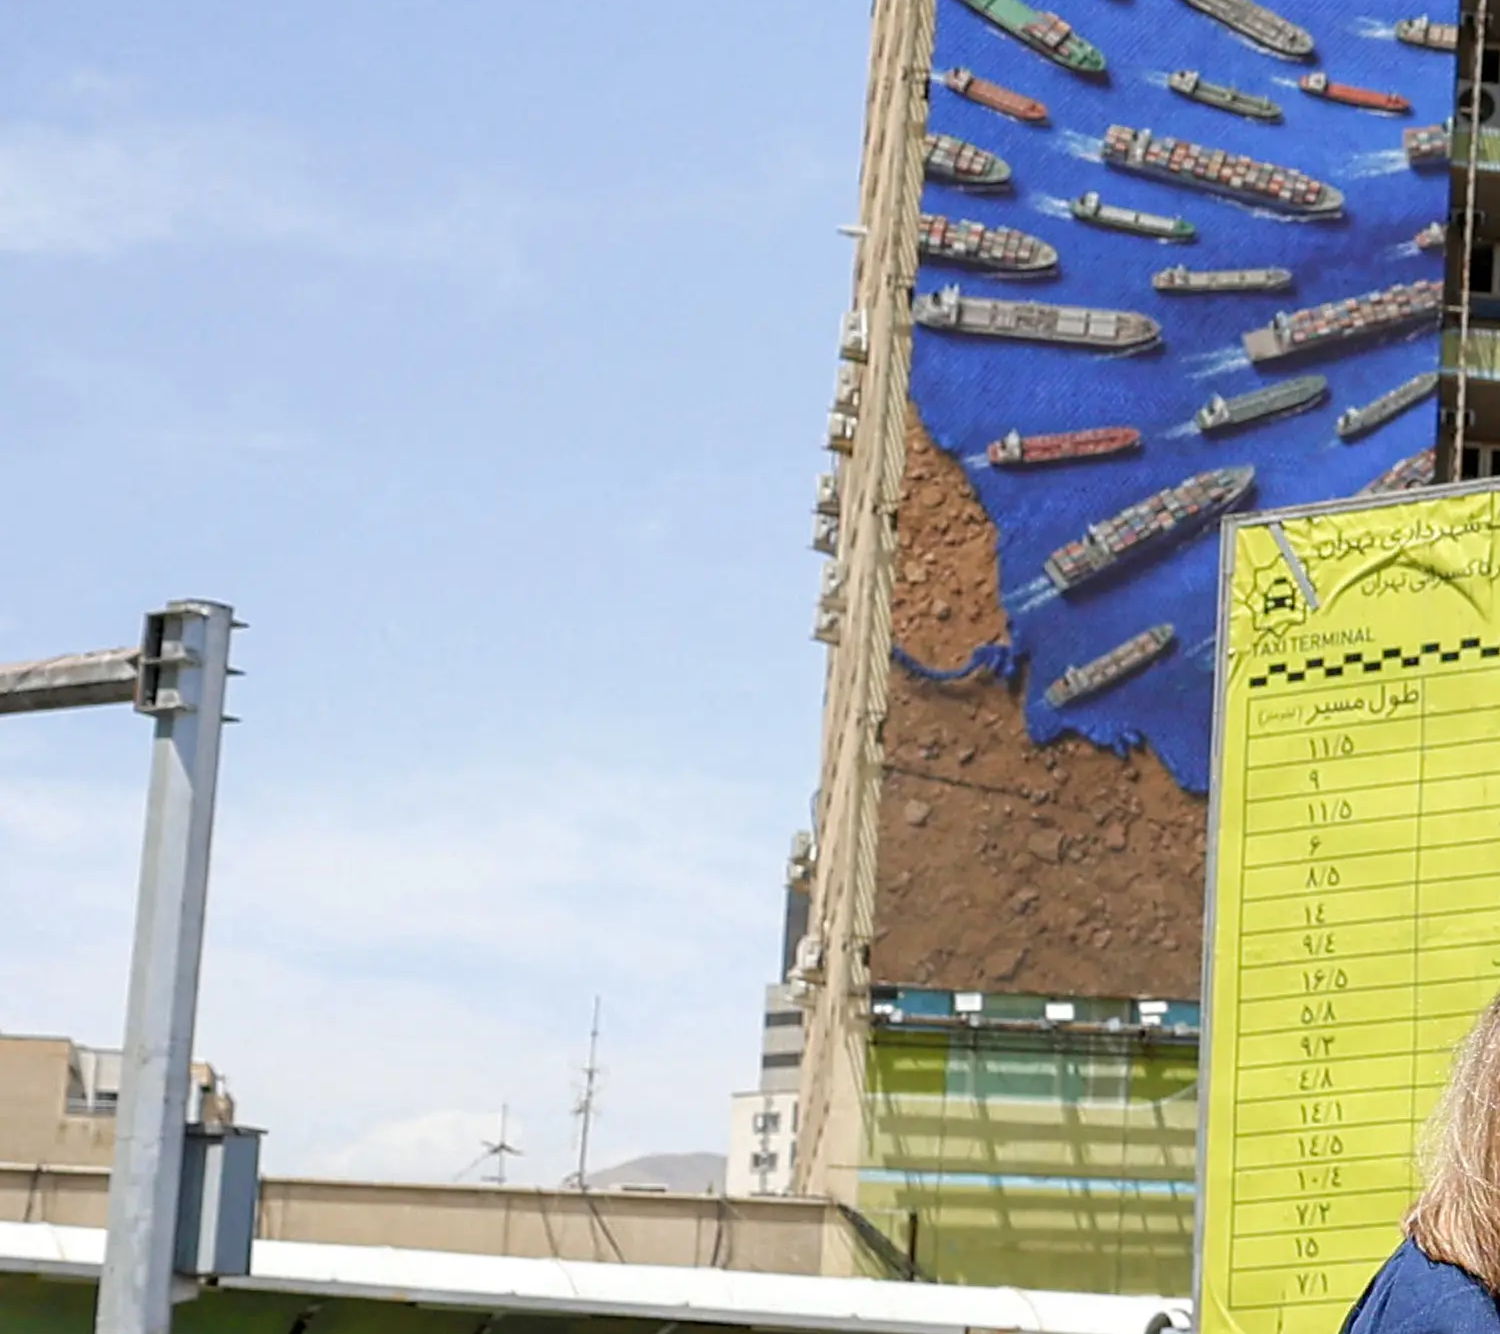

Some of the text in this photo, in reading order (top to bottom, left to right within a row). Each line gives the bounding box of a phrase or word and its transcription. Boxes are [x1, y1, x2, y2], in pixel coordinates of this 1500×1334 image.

[1317, 529, 1376, 562] تهران
[1360, 569, 1407, 599] تهران
[1250, 628, 1376, 658] TAXI TERMINAL
[1306, 698, 1365, 726] مسیر
[1368, 681, 1420, 717] طول
[1309, 770, 1321, 790] ۹
[1296, 1235, 1319, 1259] ۱۵
